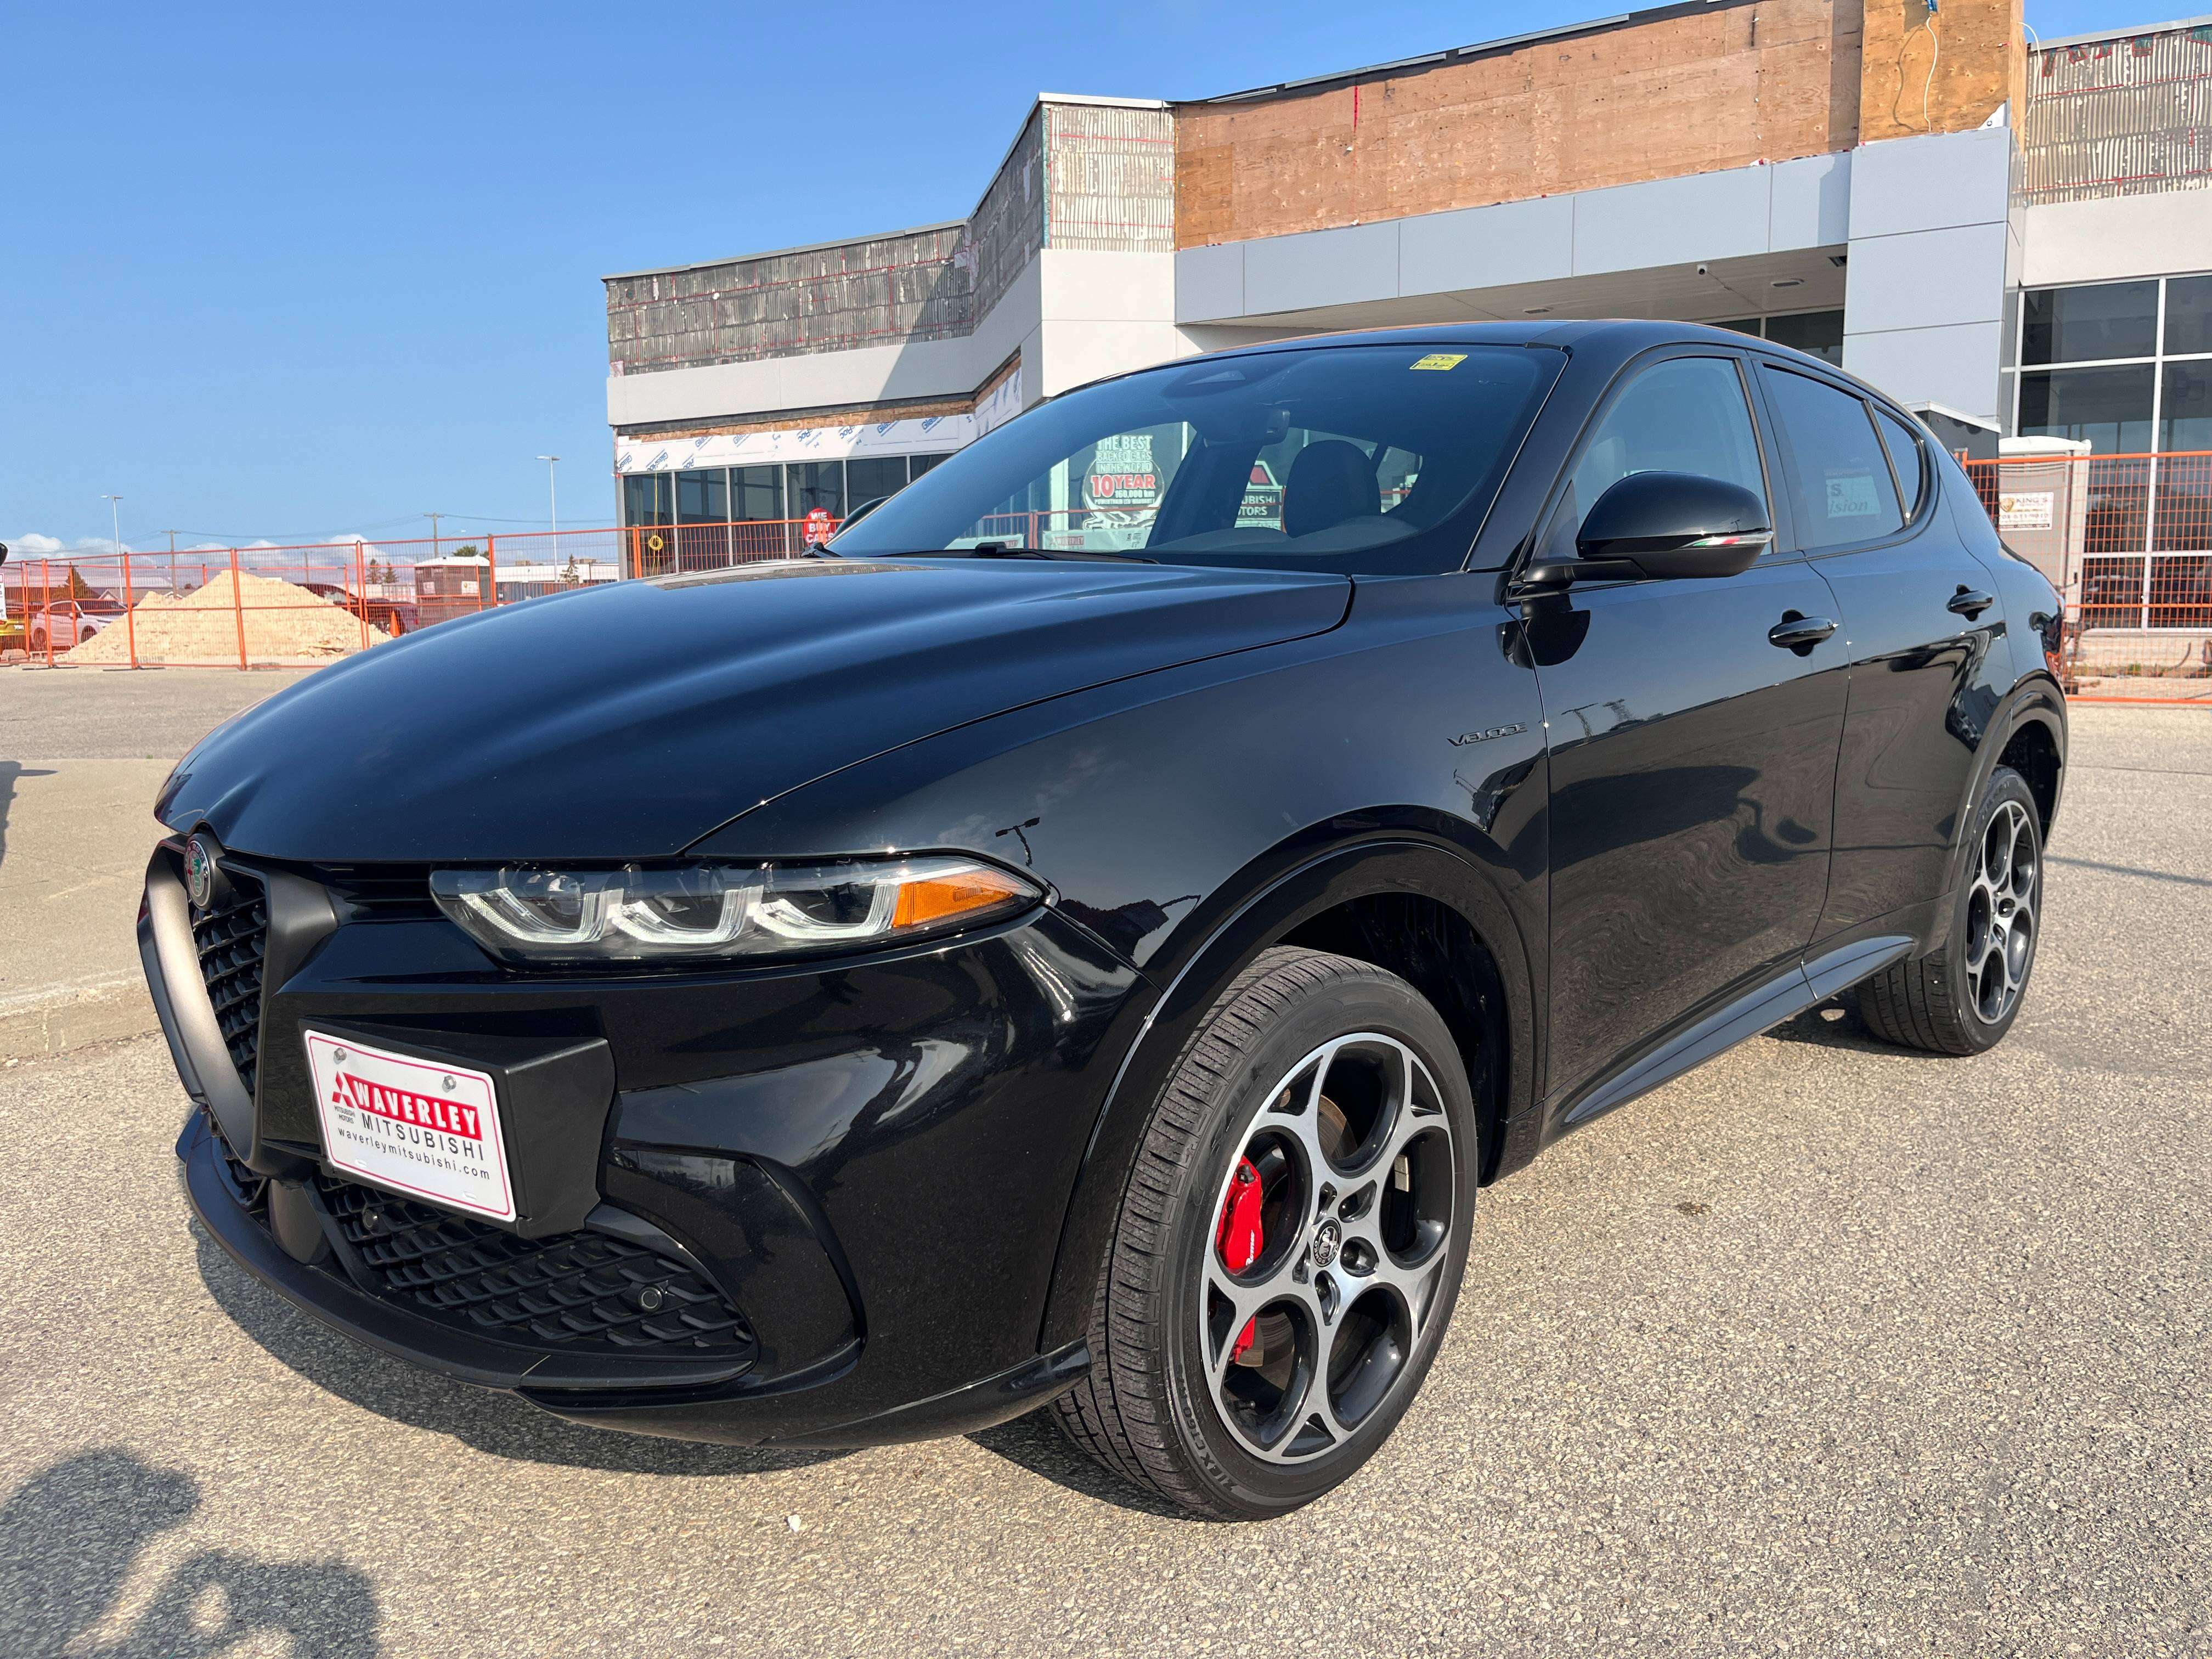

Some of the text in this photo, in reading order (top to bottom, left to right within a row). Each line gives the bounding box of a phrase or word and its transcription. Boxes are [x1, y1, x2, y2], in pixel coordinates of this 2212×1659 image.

[1121, 435, 1153, 450] BEST
[1091, 475, 1155, 498] 10 YEAR
[334, 1105, 356, 1117] MITSUBISHI
[353, 1080, 477, 1135] WAVERLEY
[338, 1127, 490, 1180] waverleymitsubishi.com
[362, 1112, 484, 1161] MITSUBISHI
[1200, 1452, 1238, 1491] ZIEX
